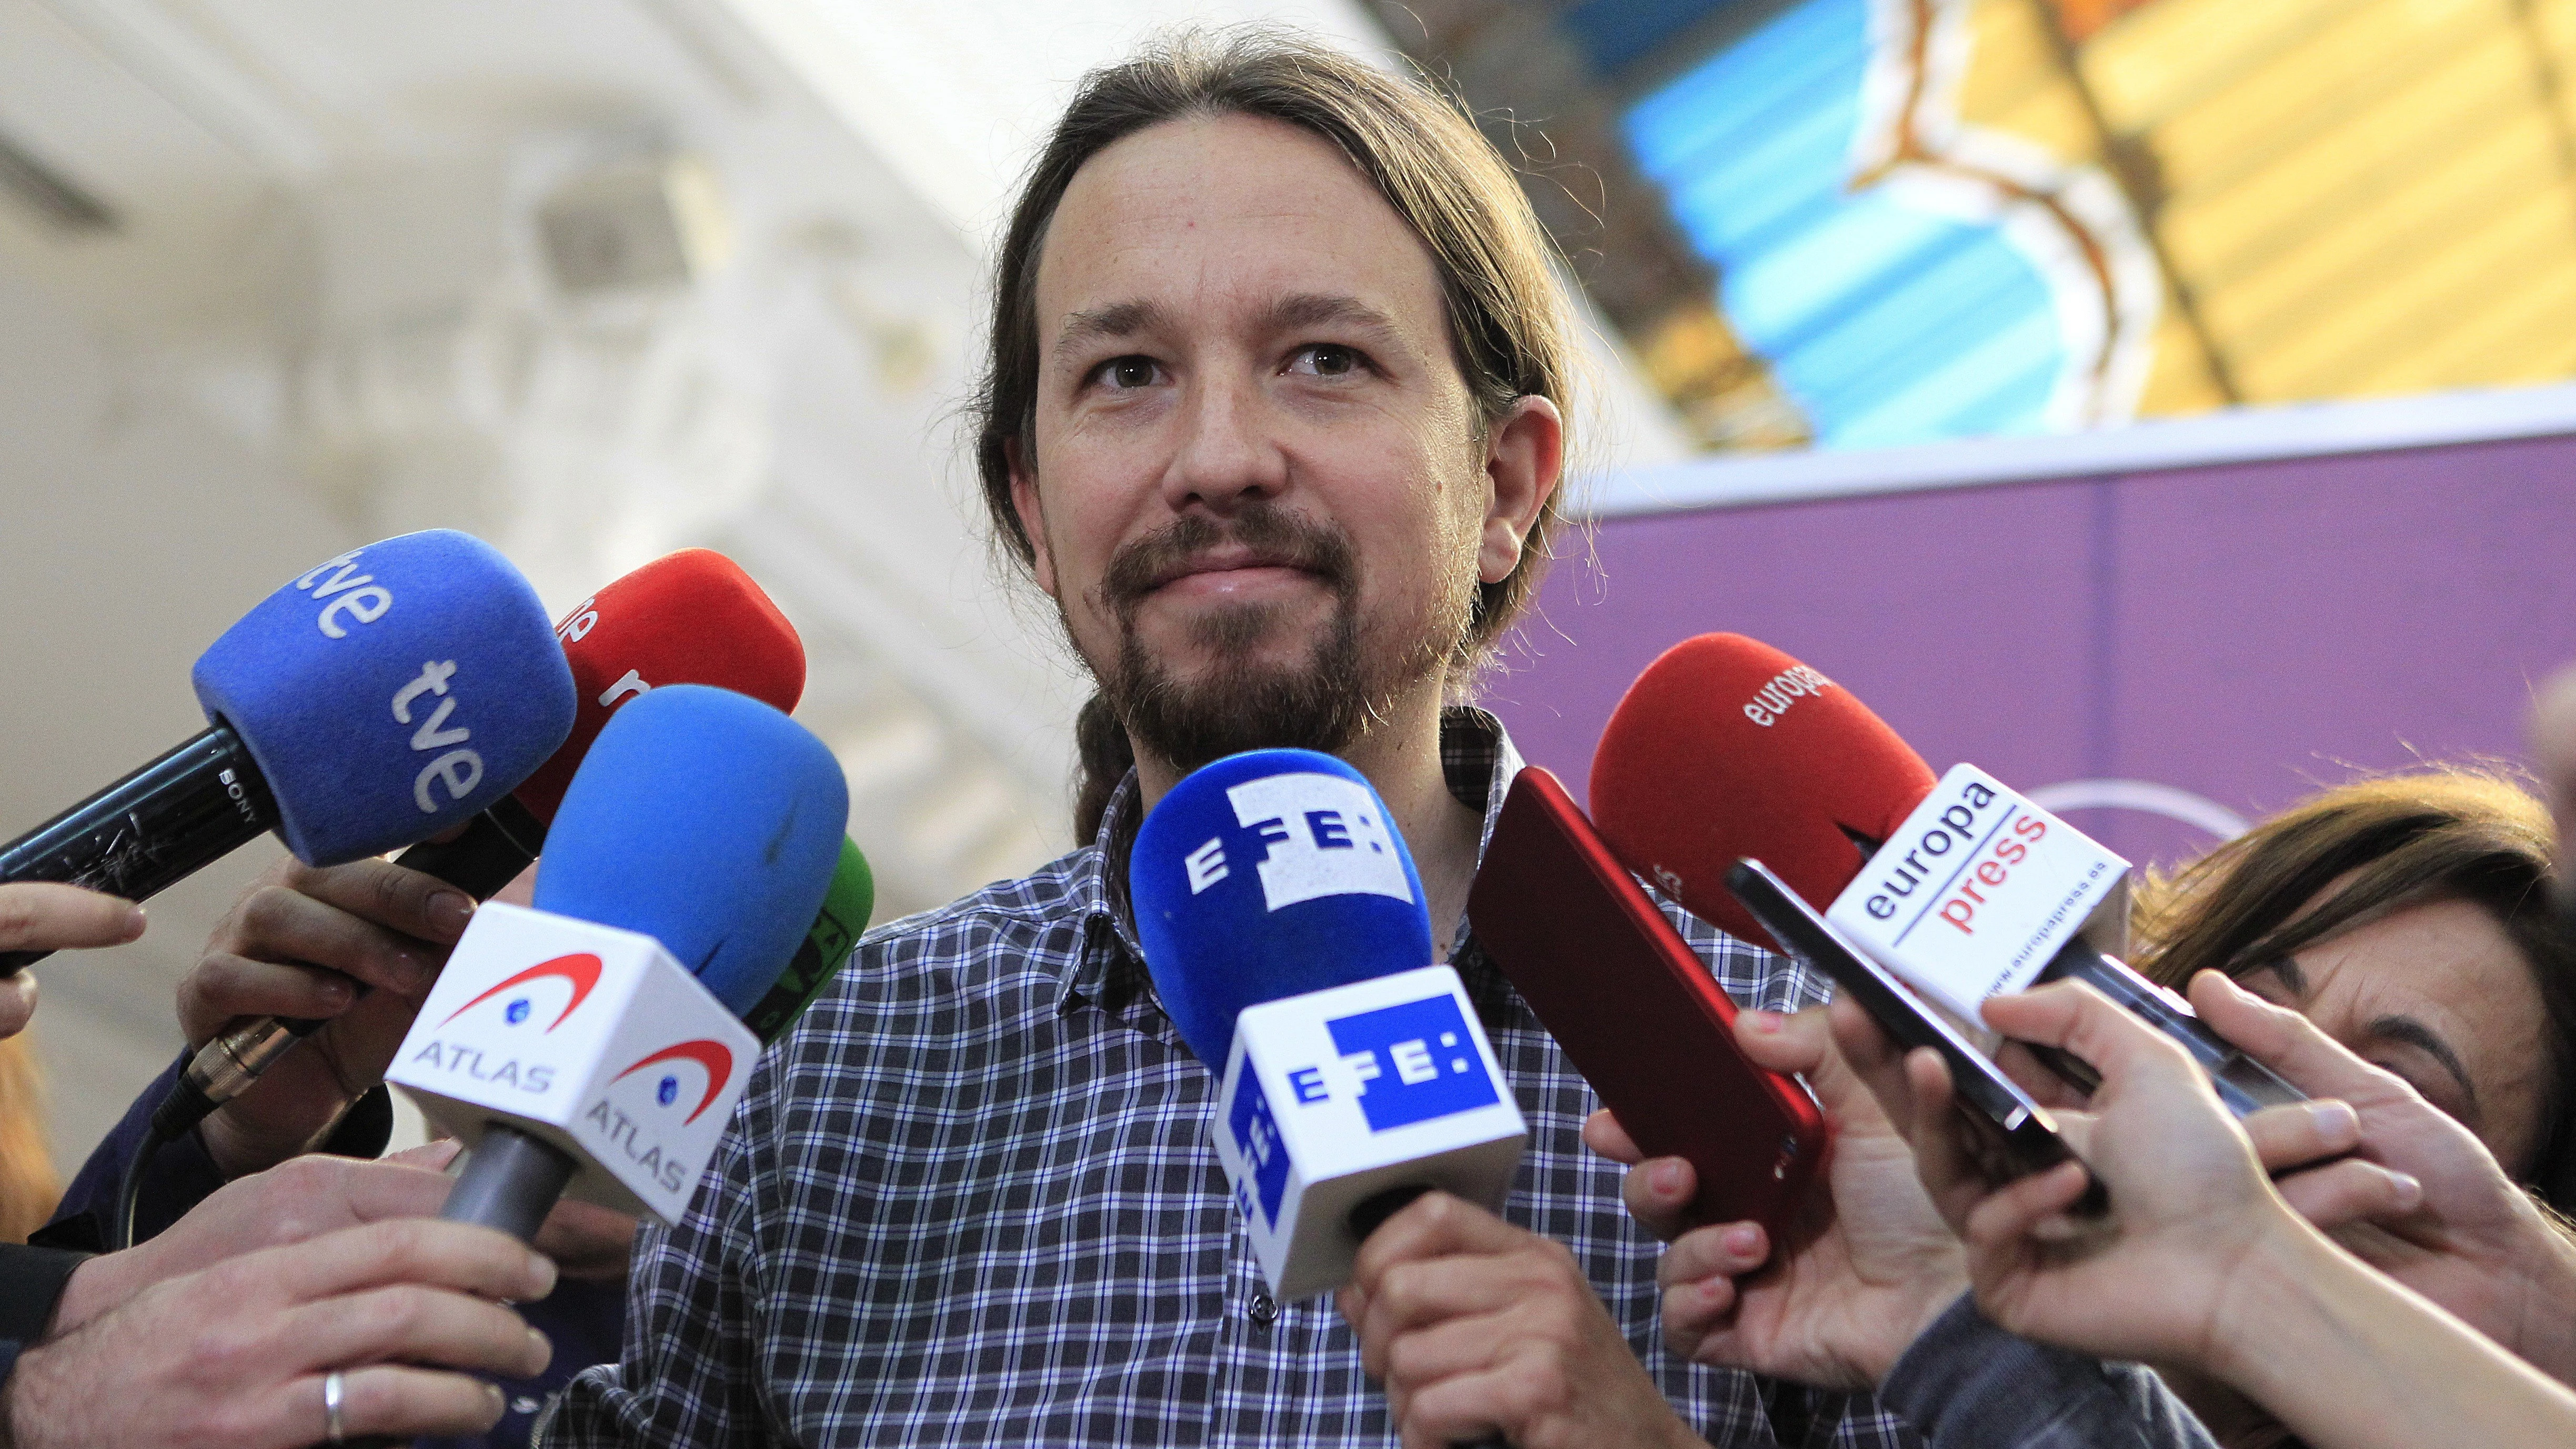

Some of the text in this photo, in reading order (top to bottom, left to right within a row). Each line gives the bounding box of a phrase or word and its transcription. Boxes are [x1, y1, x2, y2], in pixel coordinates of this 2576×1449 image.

[296, 551, 393, 639] tve
[391, 659, 484, 814] tve
[218, 768, 257, 823] SONY
[1865, 781, 1997, 920] europa
[1938, 815, 2047, 936] press
[412, 1040, 556, 1094] ATLAS
[586, 1100, 688, 1194] ATLAS
